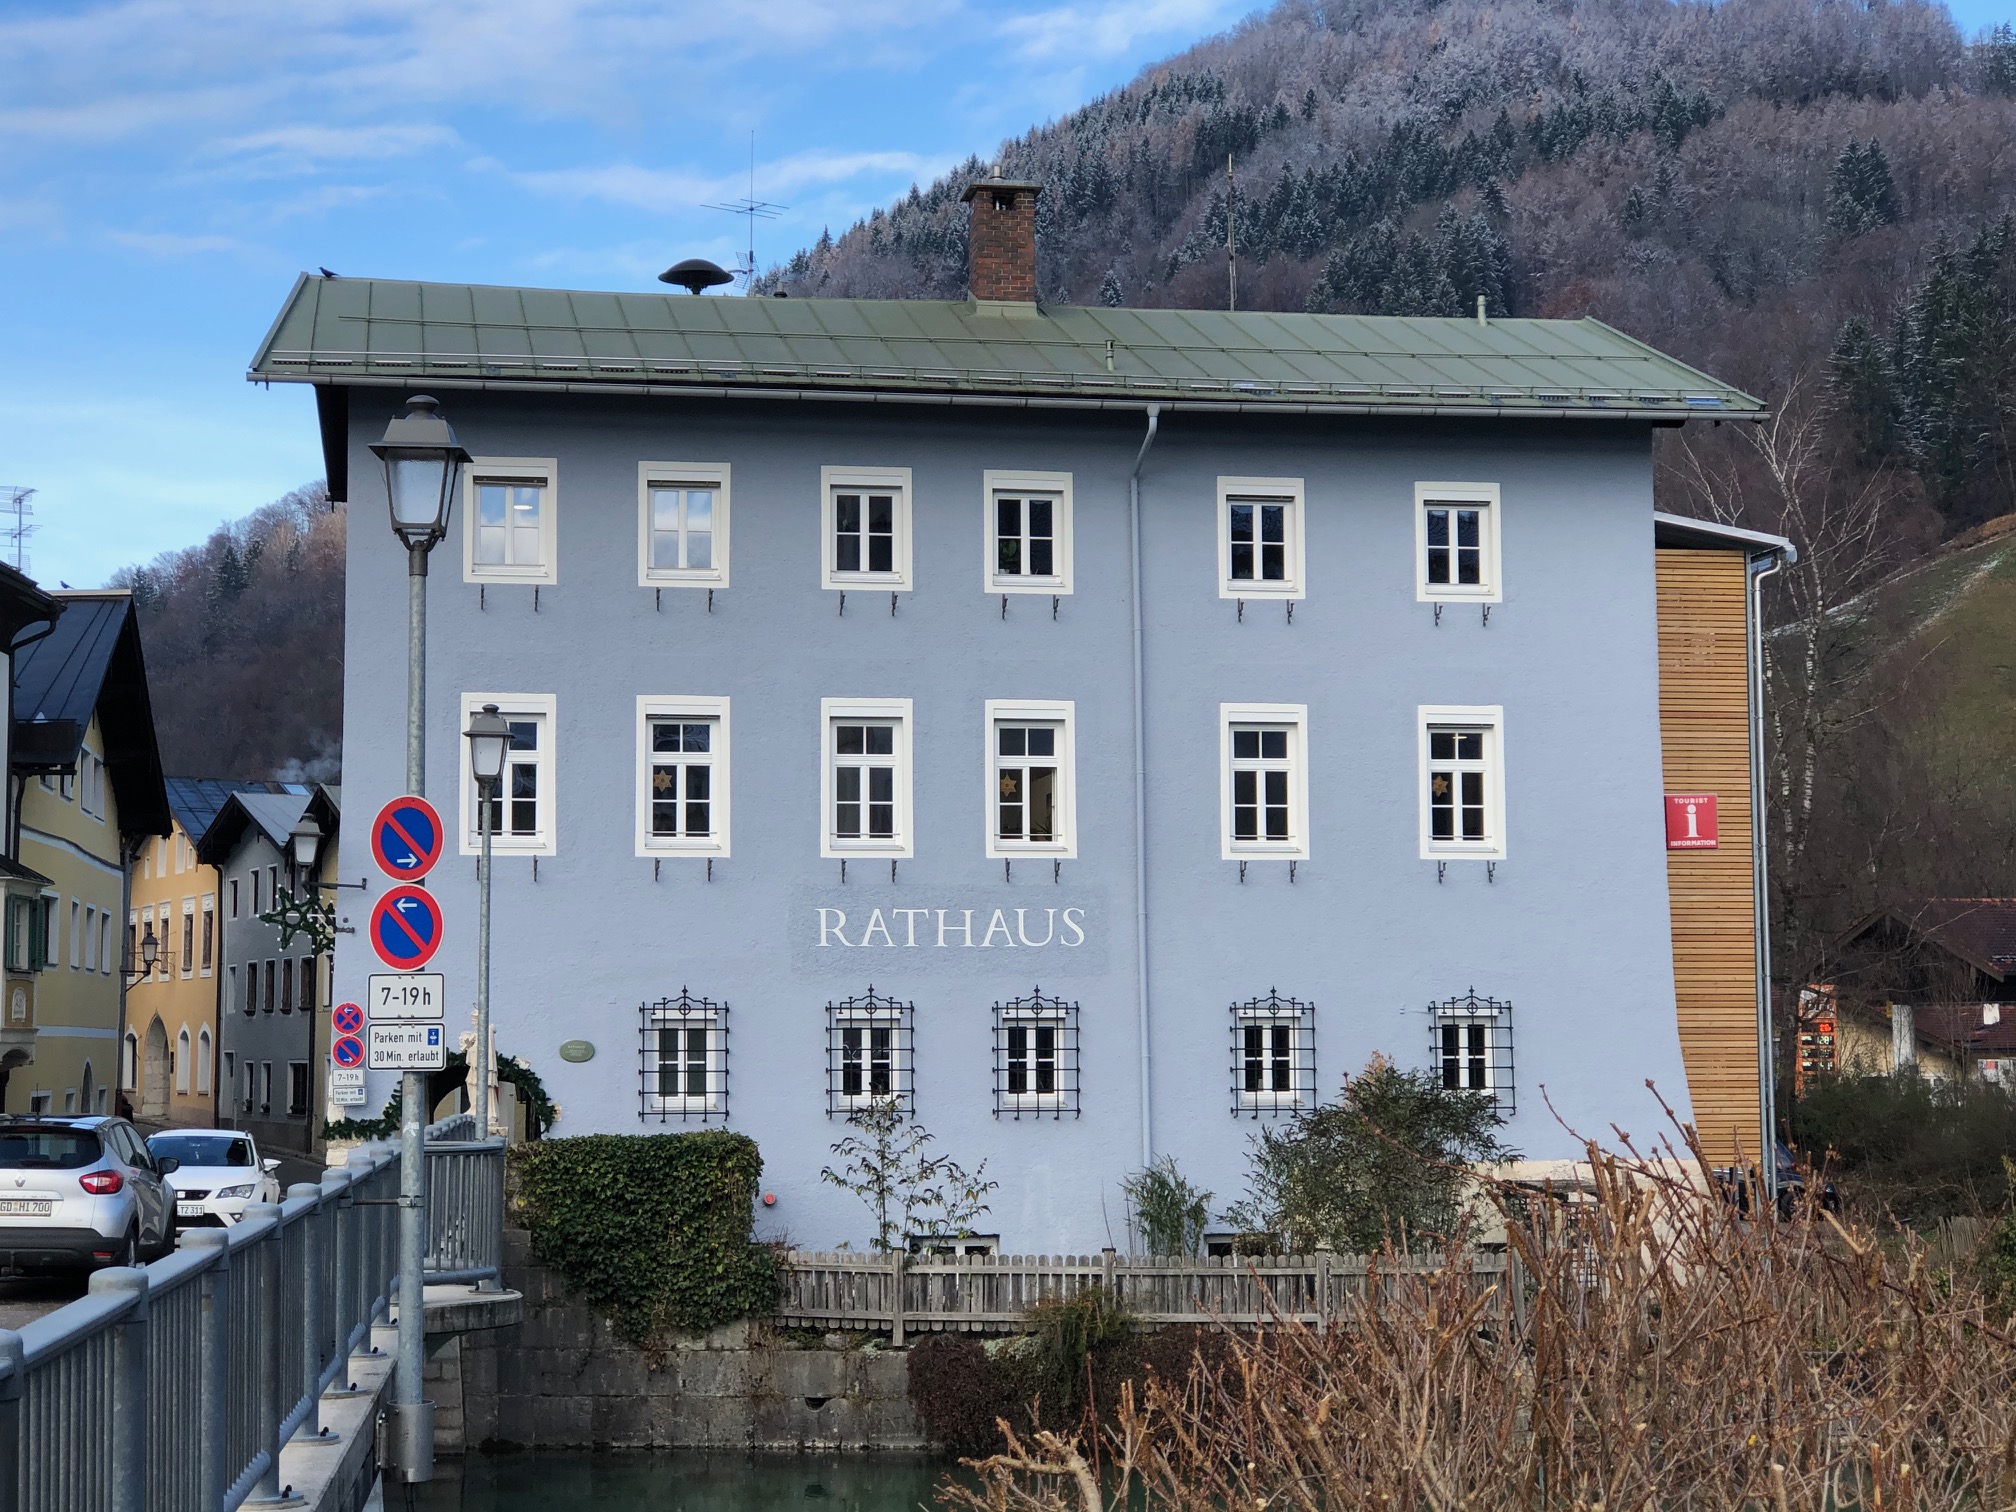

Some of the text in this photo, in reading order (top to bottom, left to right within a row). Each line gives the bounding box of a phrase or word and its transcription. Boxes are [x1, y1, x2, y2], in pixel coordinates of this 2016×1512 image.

[814, 907, 1086, 948] RATHAUS
[374, 1031, 422, 1044] Parken mit
[374, 1049, 440, 1062] 30 Min. erlaubt
[19, 1202, 30, 1212] HI
[32, 1202, 50, 1212] 700
[180, 1206, 203, 1215] TZ 311
